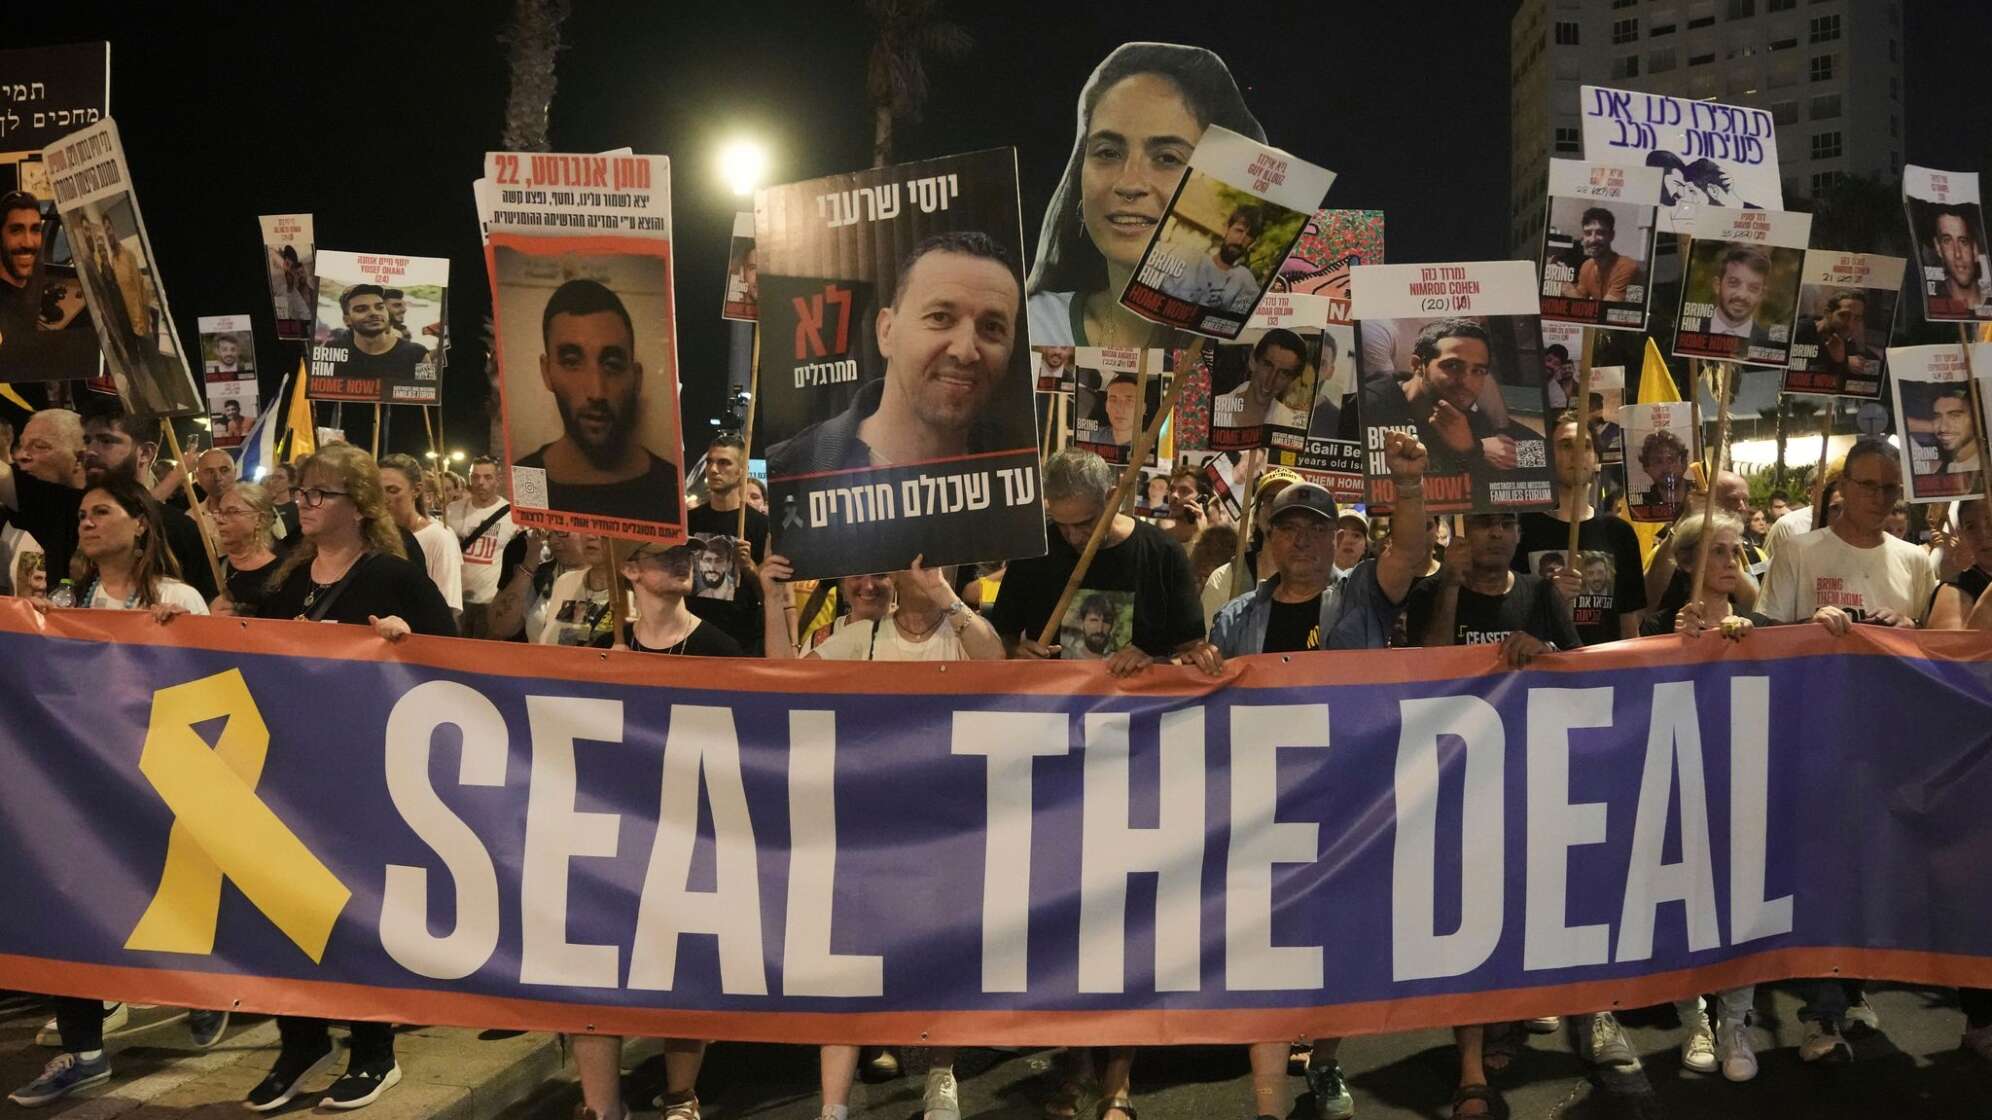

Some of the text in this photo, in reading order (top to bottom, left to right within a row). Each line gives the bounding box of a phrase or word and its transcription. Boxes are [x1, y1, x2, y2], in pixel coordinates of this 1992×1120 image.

[1588, 89, 1632, 124] את
[1647, 96, 1680, 125] לנו
[34, 108, 99, 128] מחכים
[1609, 120, 1657, 149] הלב
[495, 154, 519, 184] 22
[613, 158, 651, 191] מתן
[502, 190, 523, 205] קשה
[526, 191, 547, 205] נפצע
[604, 193, 632, 208] לשמור
[634, 196, 650, 208] יצא
[816, 174, 958, 228] יוסי שרעבי
[544, 213, 586, 228] מהרשימה
[588, 215, 619, 229] המדינה
[637, 217, 665, 230] והוצא
[1148, 249, 1186, 279] BRING
[1138, 266, 1168, 290] HIM
[1421, 267, 1465, 282] נמרוד כהן
[1545, 264, 1575, 282] BRING
[1409, 281, 1480, 296] NIMROD COHEN
[1421, 298, 1449, 312] (20)
[1684, 302, 1714, 317] BRING
[792, 283, 853, 361] לא
[313, 346, 349, 362] BRING
[311, 361, 335, 377] HIM
[794, 359, 858, 388] מתרגלים
[311, 378, 381, 394] HOME NOW!
[1214, 398, 1244, 412] BRING
[1076, 418, 1098, 431] BRING
[1213, 412, 1233, 428] HIM
[1343, 445, 1361, 458] Be
[1297, 456, 1327, 465] years
[1330, 459, 1346, 468] old
[1369, 452, 1391, 475] HI
[1305, 475, 1335, 488] THEM
[1424, 473, 1472, 500] NOW!
[808, 467, 1035, 528] עד שכולם חוזרים
[1490, 489, 1551, 502] FAMILIES FORUM
[1817, 578, 1843, 591] BRING
[1817, 592, 1863, 606] THEM HOME
[379, 676, 1794, 997] SEAL THE DEAL
